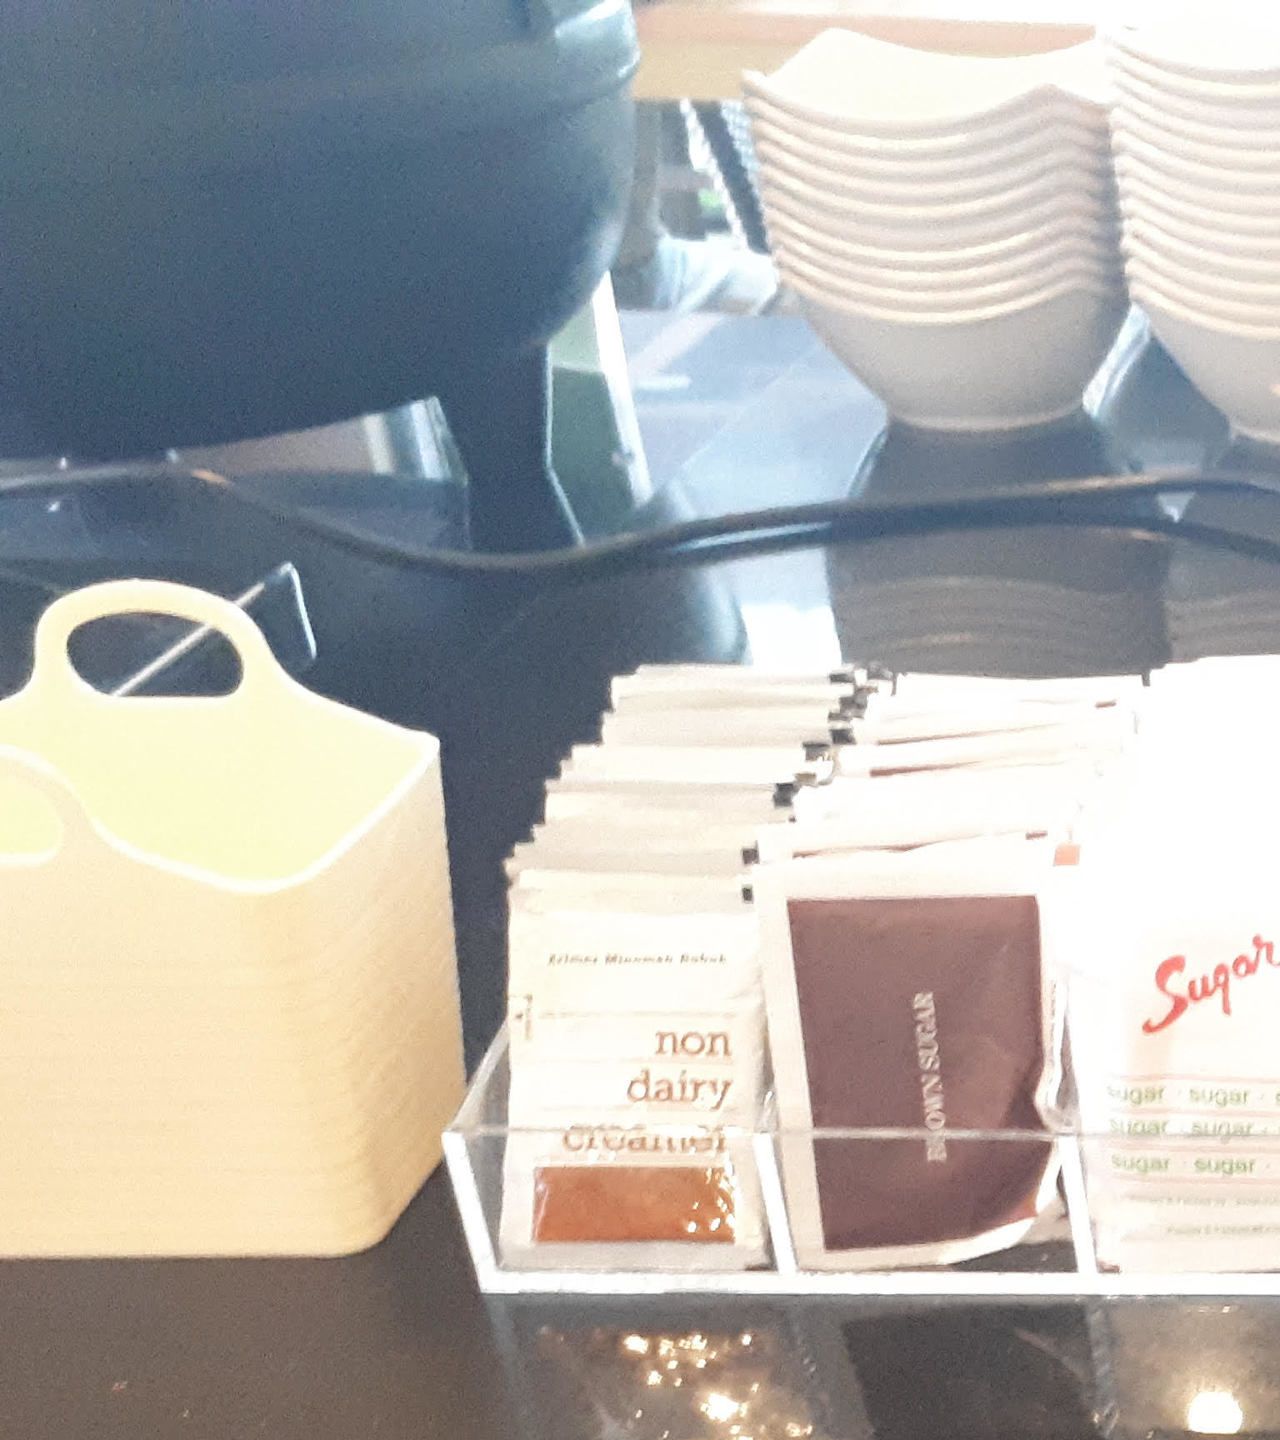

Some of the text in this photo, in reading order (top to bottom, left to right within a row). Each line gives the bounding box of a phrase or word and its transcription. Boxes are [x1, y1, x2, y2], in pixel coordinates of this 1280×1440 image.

[655, 1030, 732, 1057] non
[626, 1068, 734, 1112] dairy
[1189, 1087, 1250, 1108] sugar
[1111, 1153, 1170, 1175] sugar
[1194, 1156, 1256, 1176] sugar
